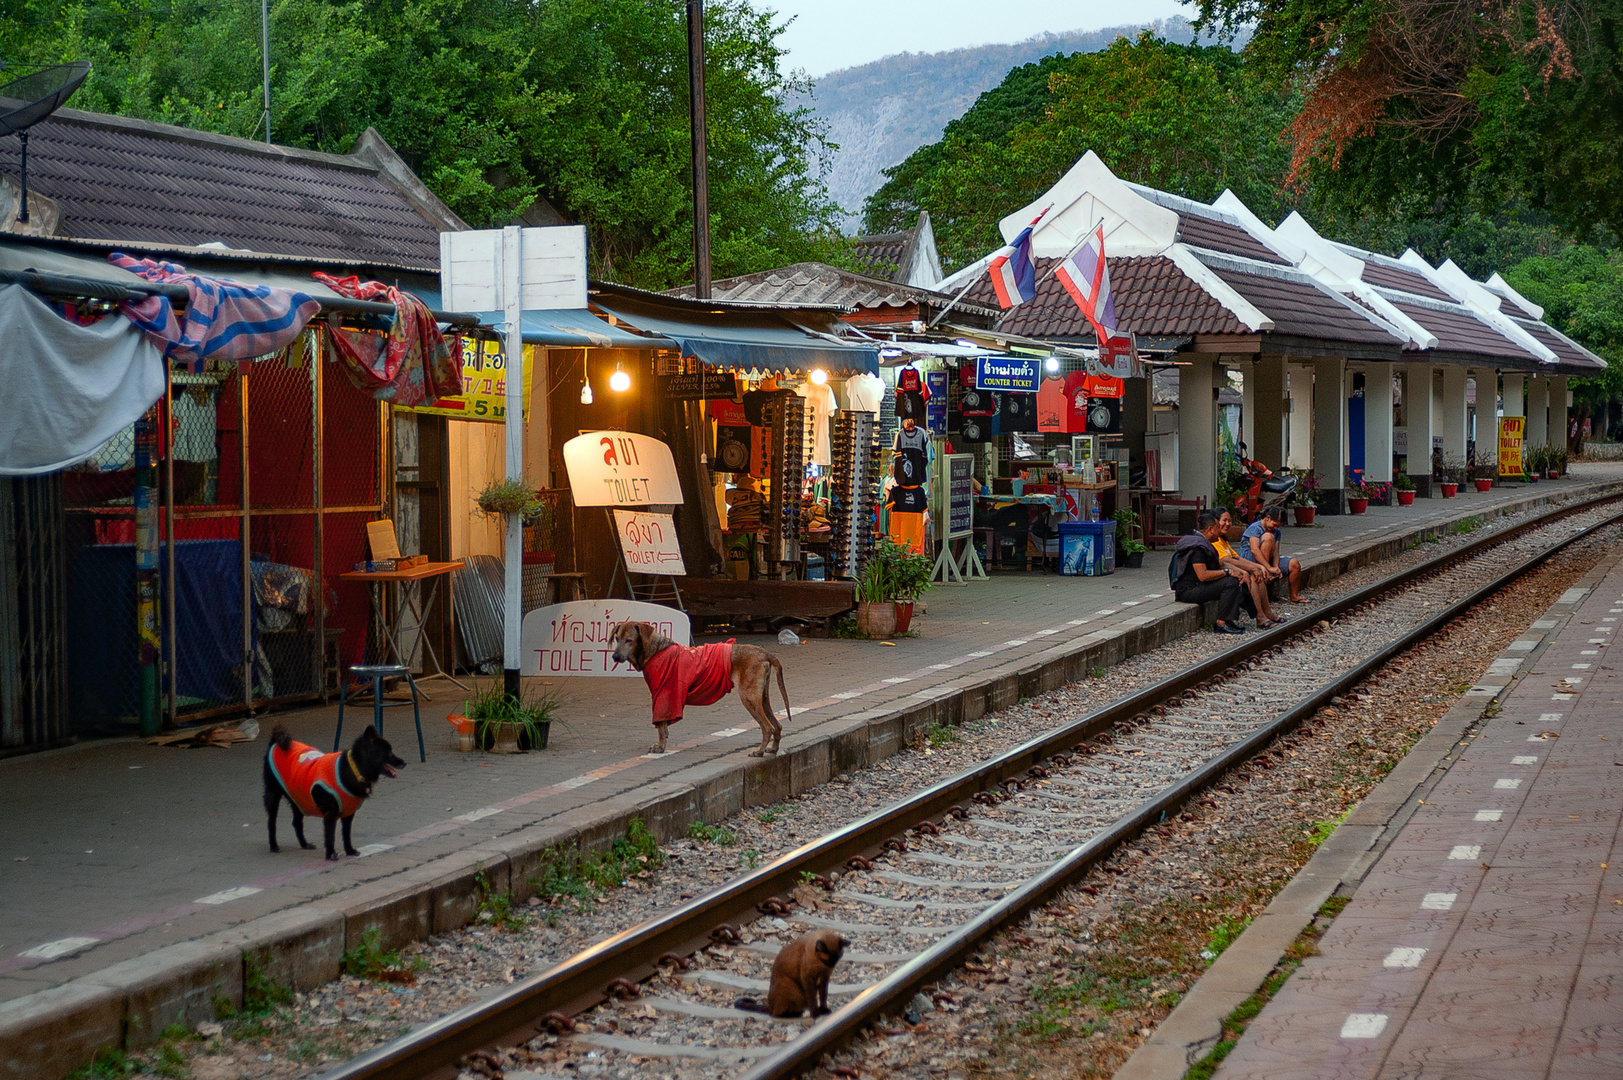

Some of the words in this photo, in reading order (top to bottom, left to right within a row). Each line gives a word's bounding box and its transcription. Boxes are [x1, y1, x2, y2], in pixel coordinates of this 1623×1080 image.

[984, 378, 1010, 386] COUNTER
[1012, 379, 1033, 388] TICKET
[474, 400, 488, 416] 5
[1500, 438, 1521, 448] TOILET
[603, 478, 651, 503] TOILET
[627, 550, 655, 564] TOILET
